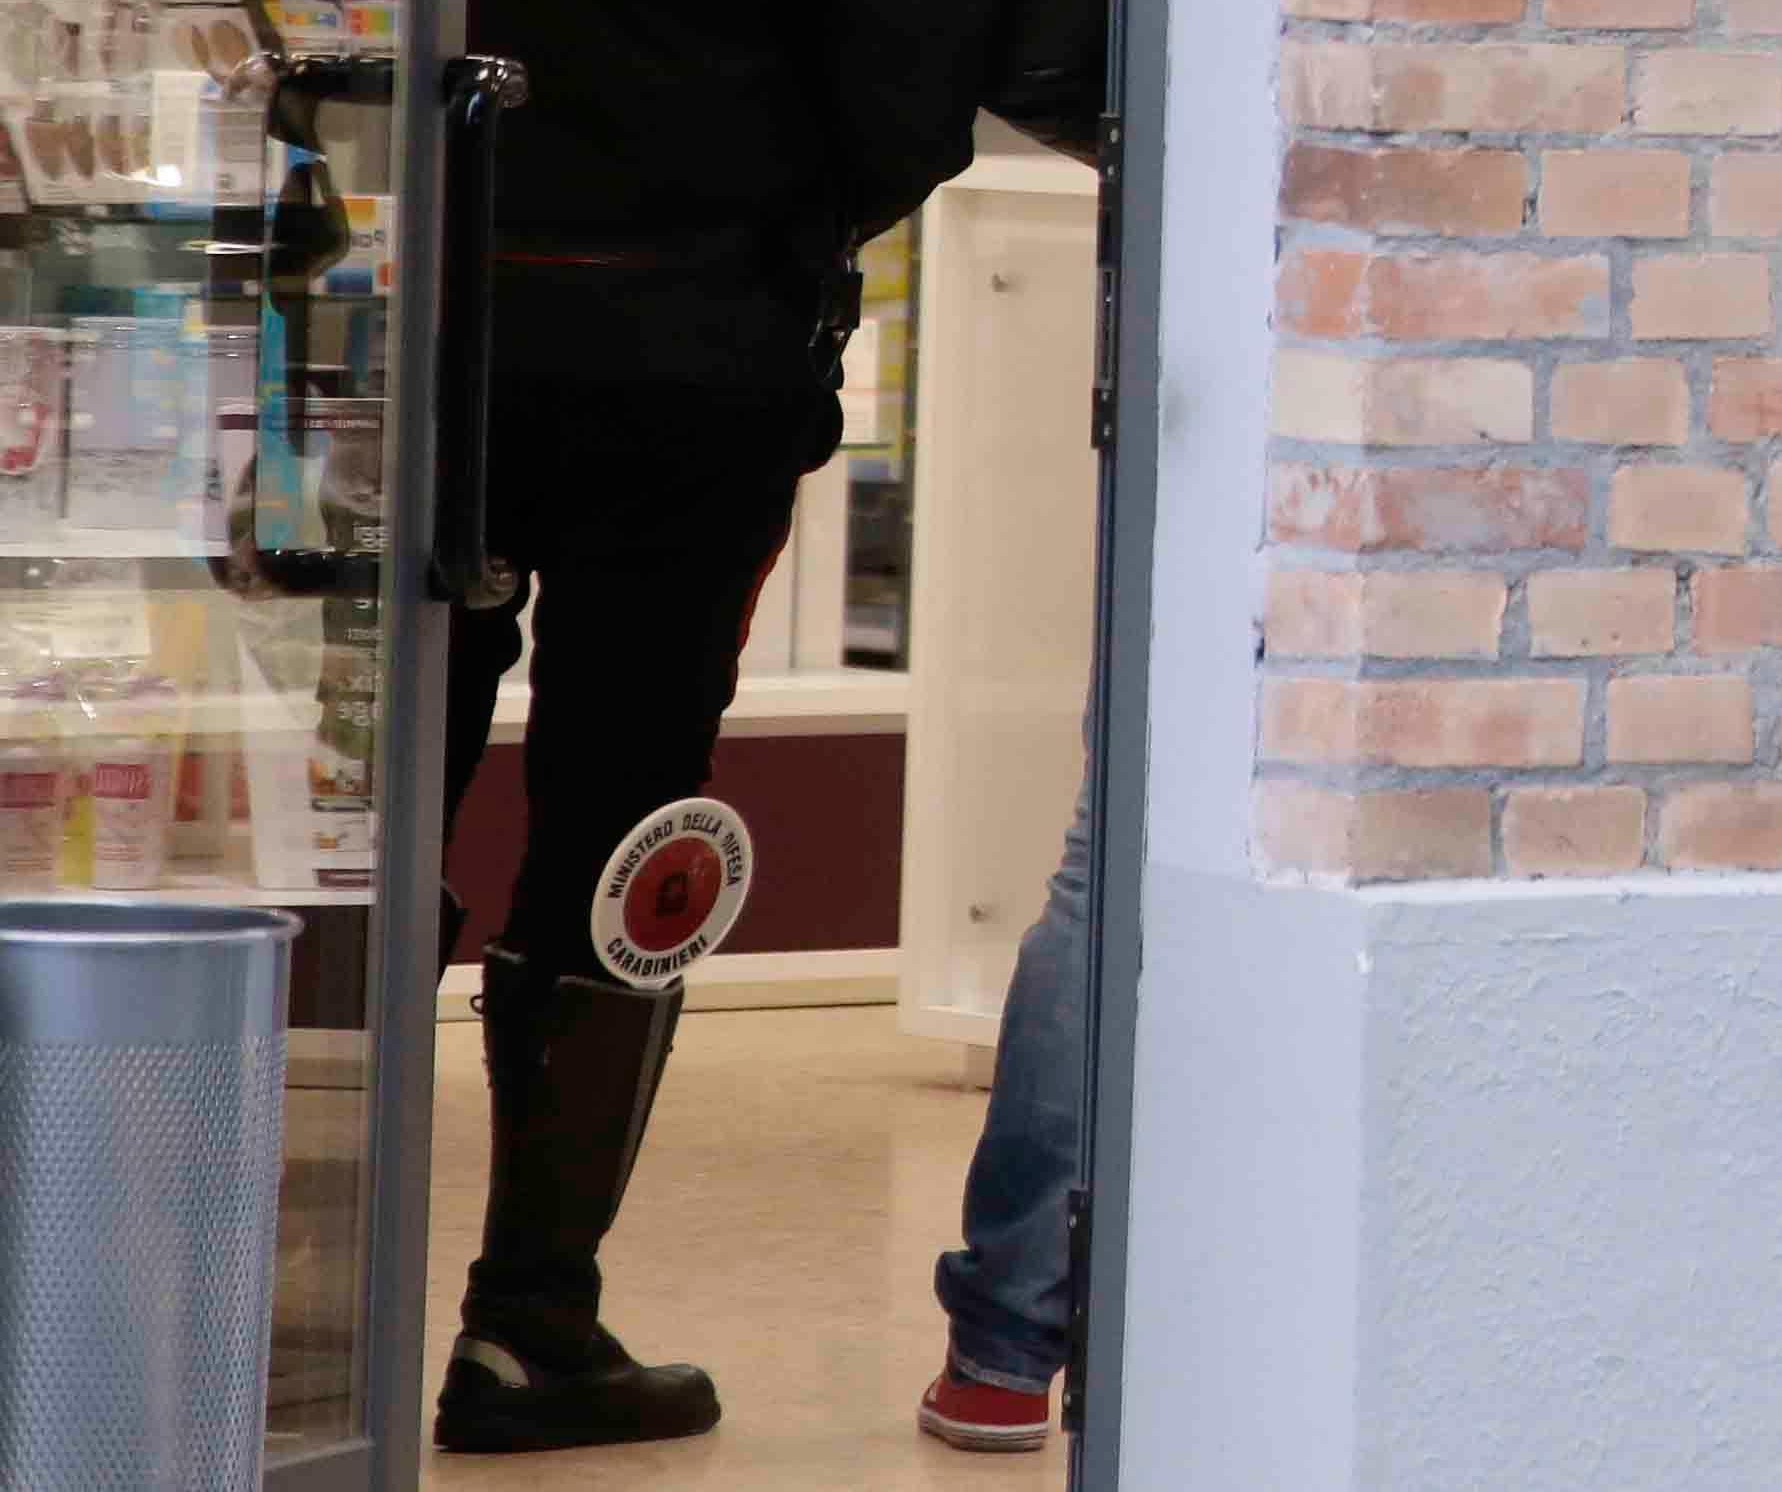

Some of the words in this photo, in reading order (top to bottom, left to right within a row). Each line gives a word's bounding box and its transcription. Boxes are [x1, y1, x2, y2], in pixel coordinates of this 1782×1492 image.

[607, 820, 674, 899] MINISTERO
[681, 812, 723, 838] DELLA
[720, 832, 744, 887] DIFESA
[607, 934, 708, 975] CARABINIERI
